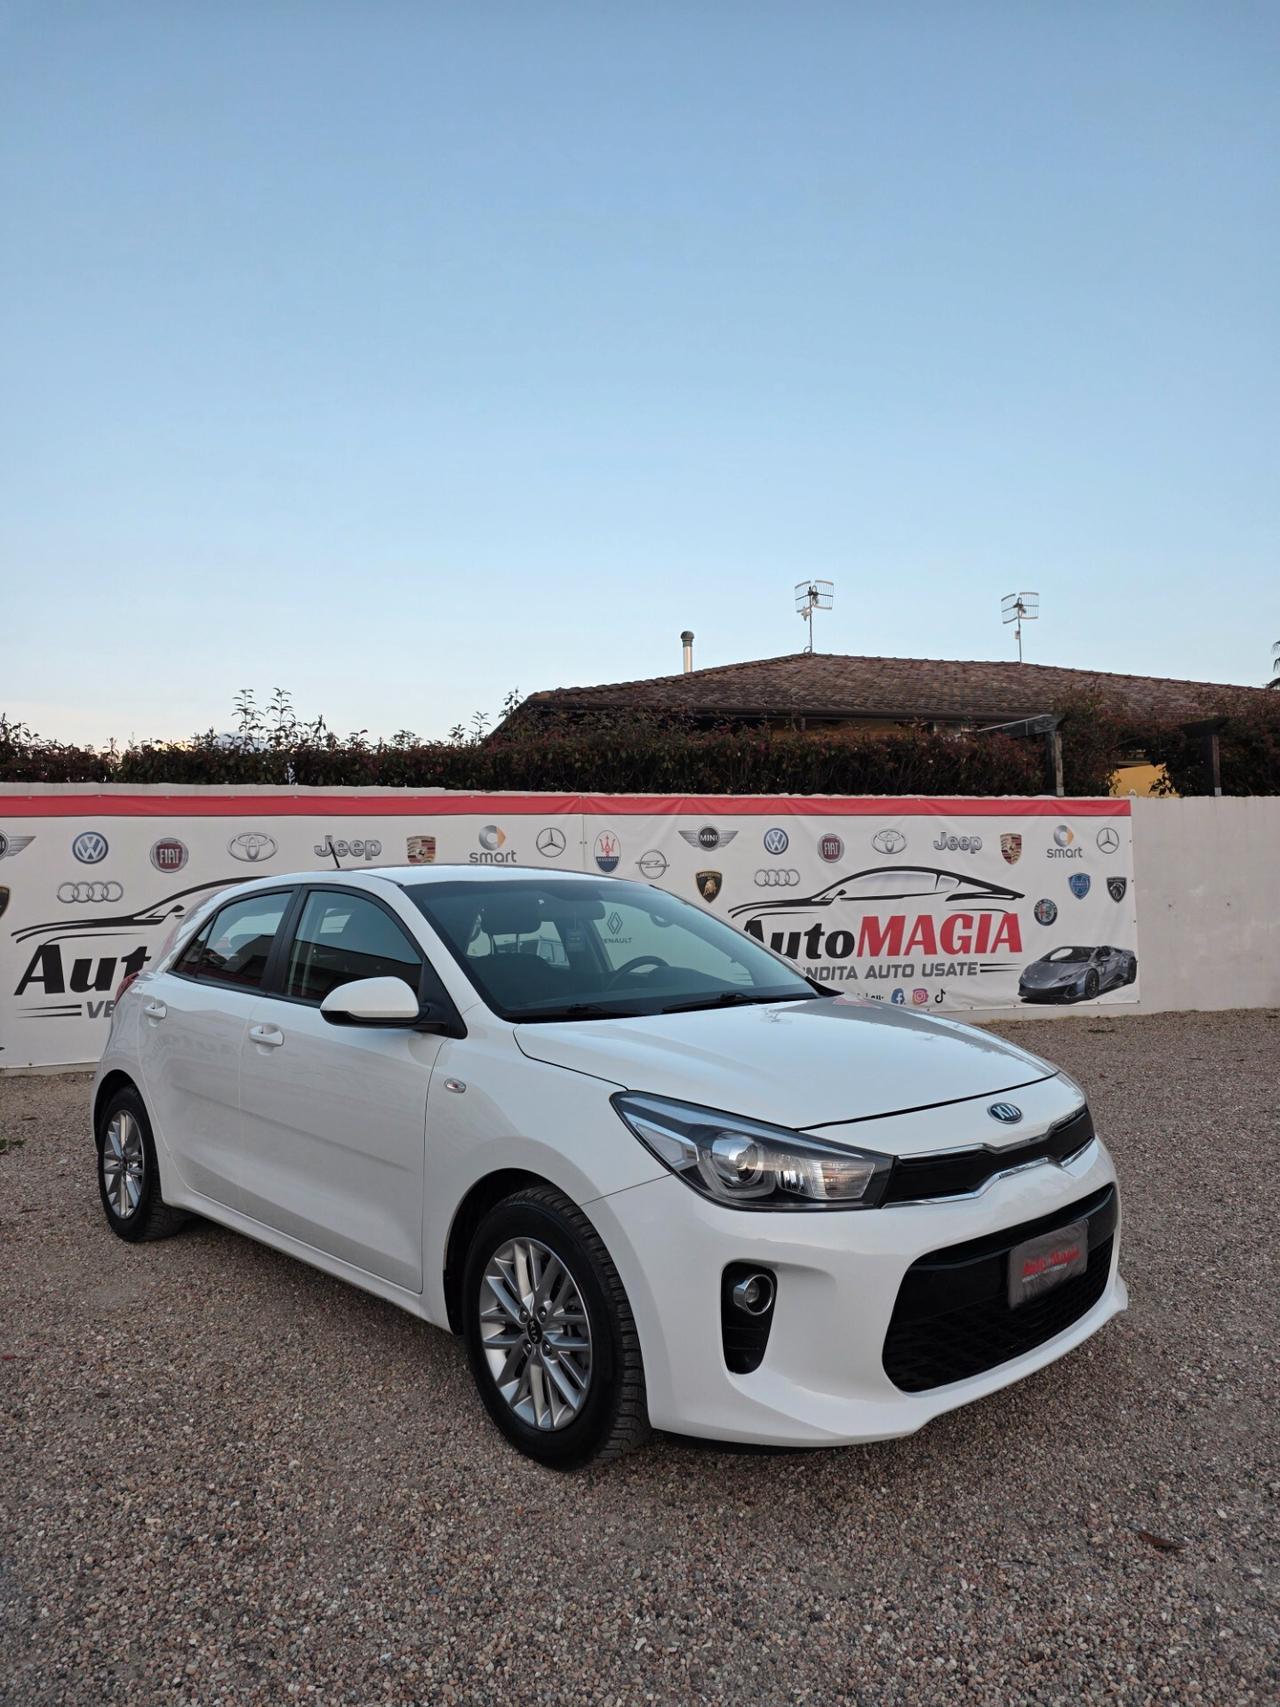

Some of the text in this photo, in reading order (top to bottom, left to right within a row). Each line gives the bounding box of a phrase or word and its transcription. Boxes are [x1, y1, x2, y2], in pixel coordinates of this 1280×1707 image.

[313, 834, 382, 861] Jeep
[823, 842, 839, 855] FIAT
[933, 831, 983, 854] Jeep
[159, 848, 181, 864] FIAT
[469, 850, 517, 863] smart
[1046, 846, 1084, 859] smart
[803, 961, 978, 981] NDITA AUTO USATE
[991, 1104, 1021, 1120] KIA
